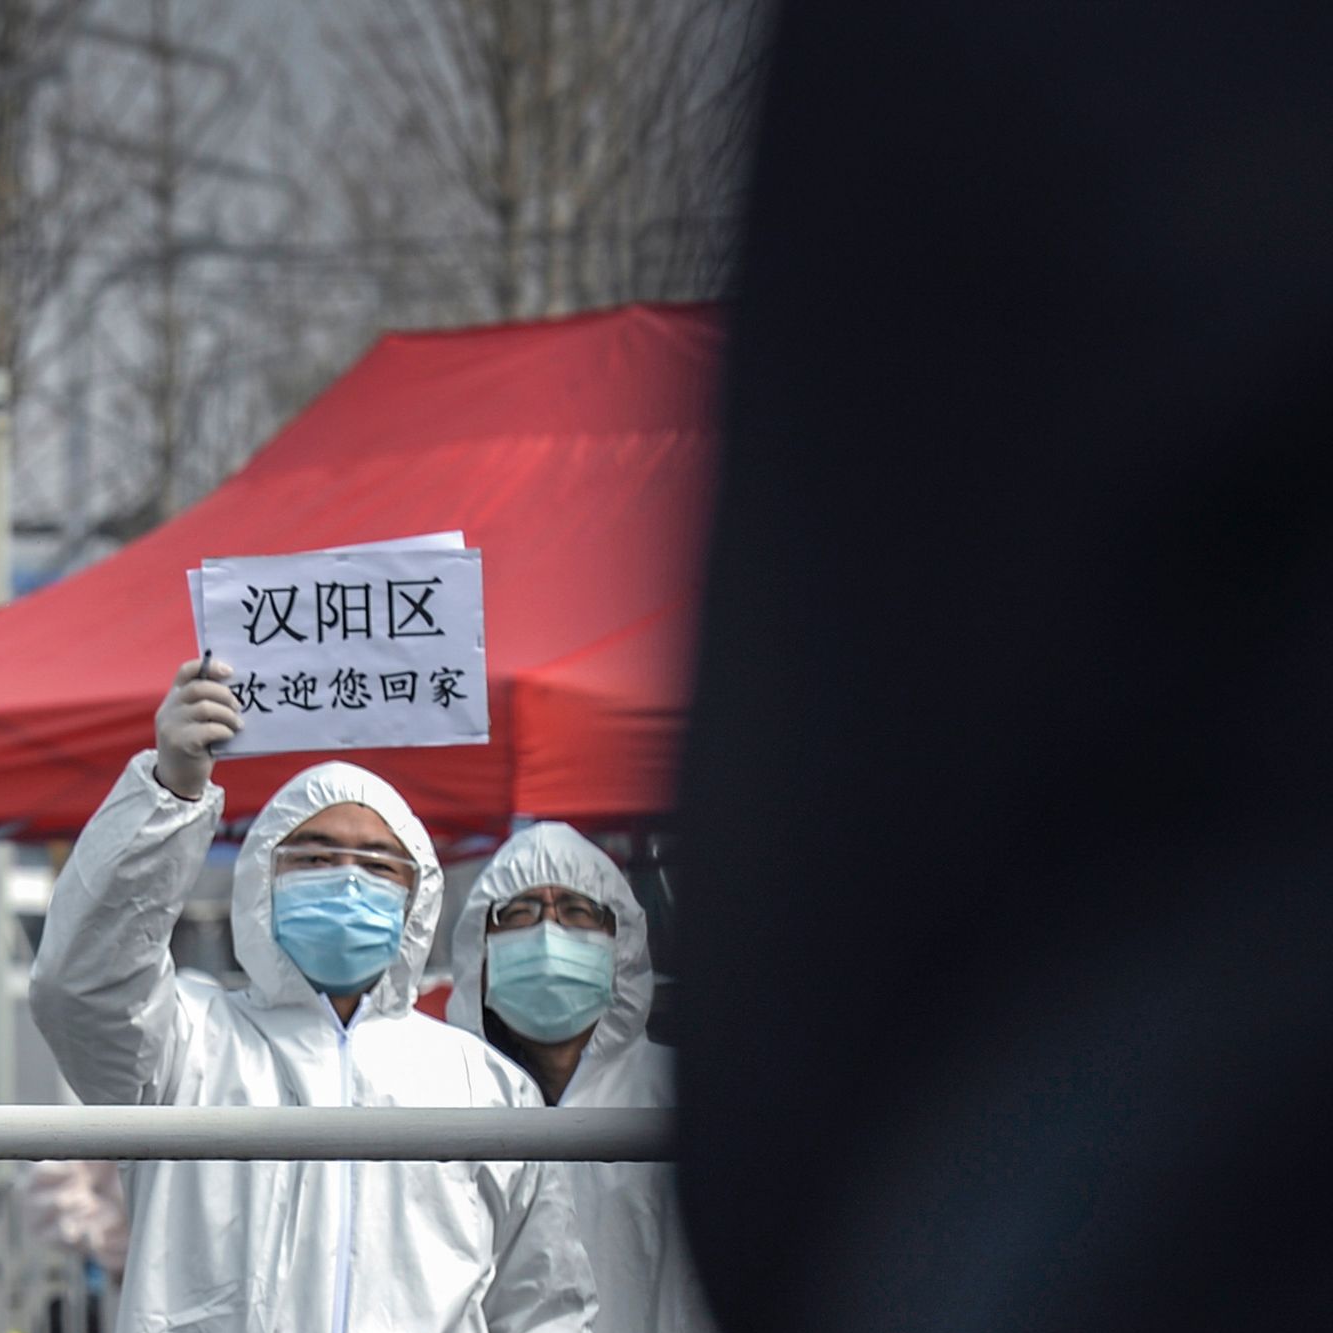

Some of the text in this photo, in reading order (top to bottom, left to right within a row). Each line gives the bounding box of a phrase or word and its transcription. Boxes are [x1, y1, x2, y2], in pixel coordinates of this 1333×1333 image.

[241, 577, 445, 645] 汉阳区
[229, 667, 467, 713] 欢迎您回家
